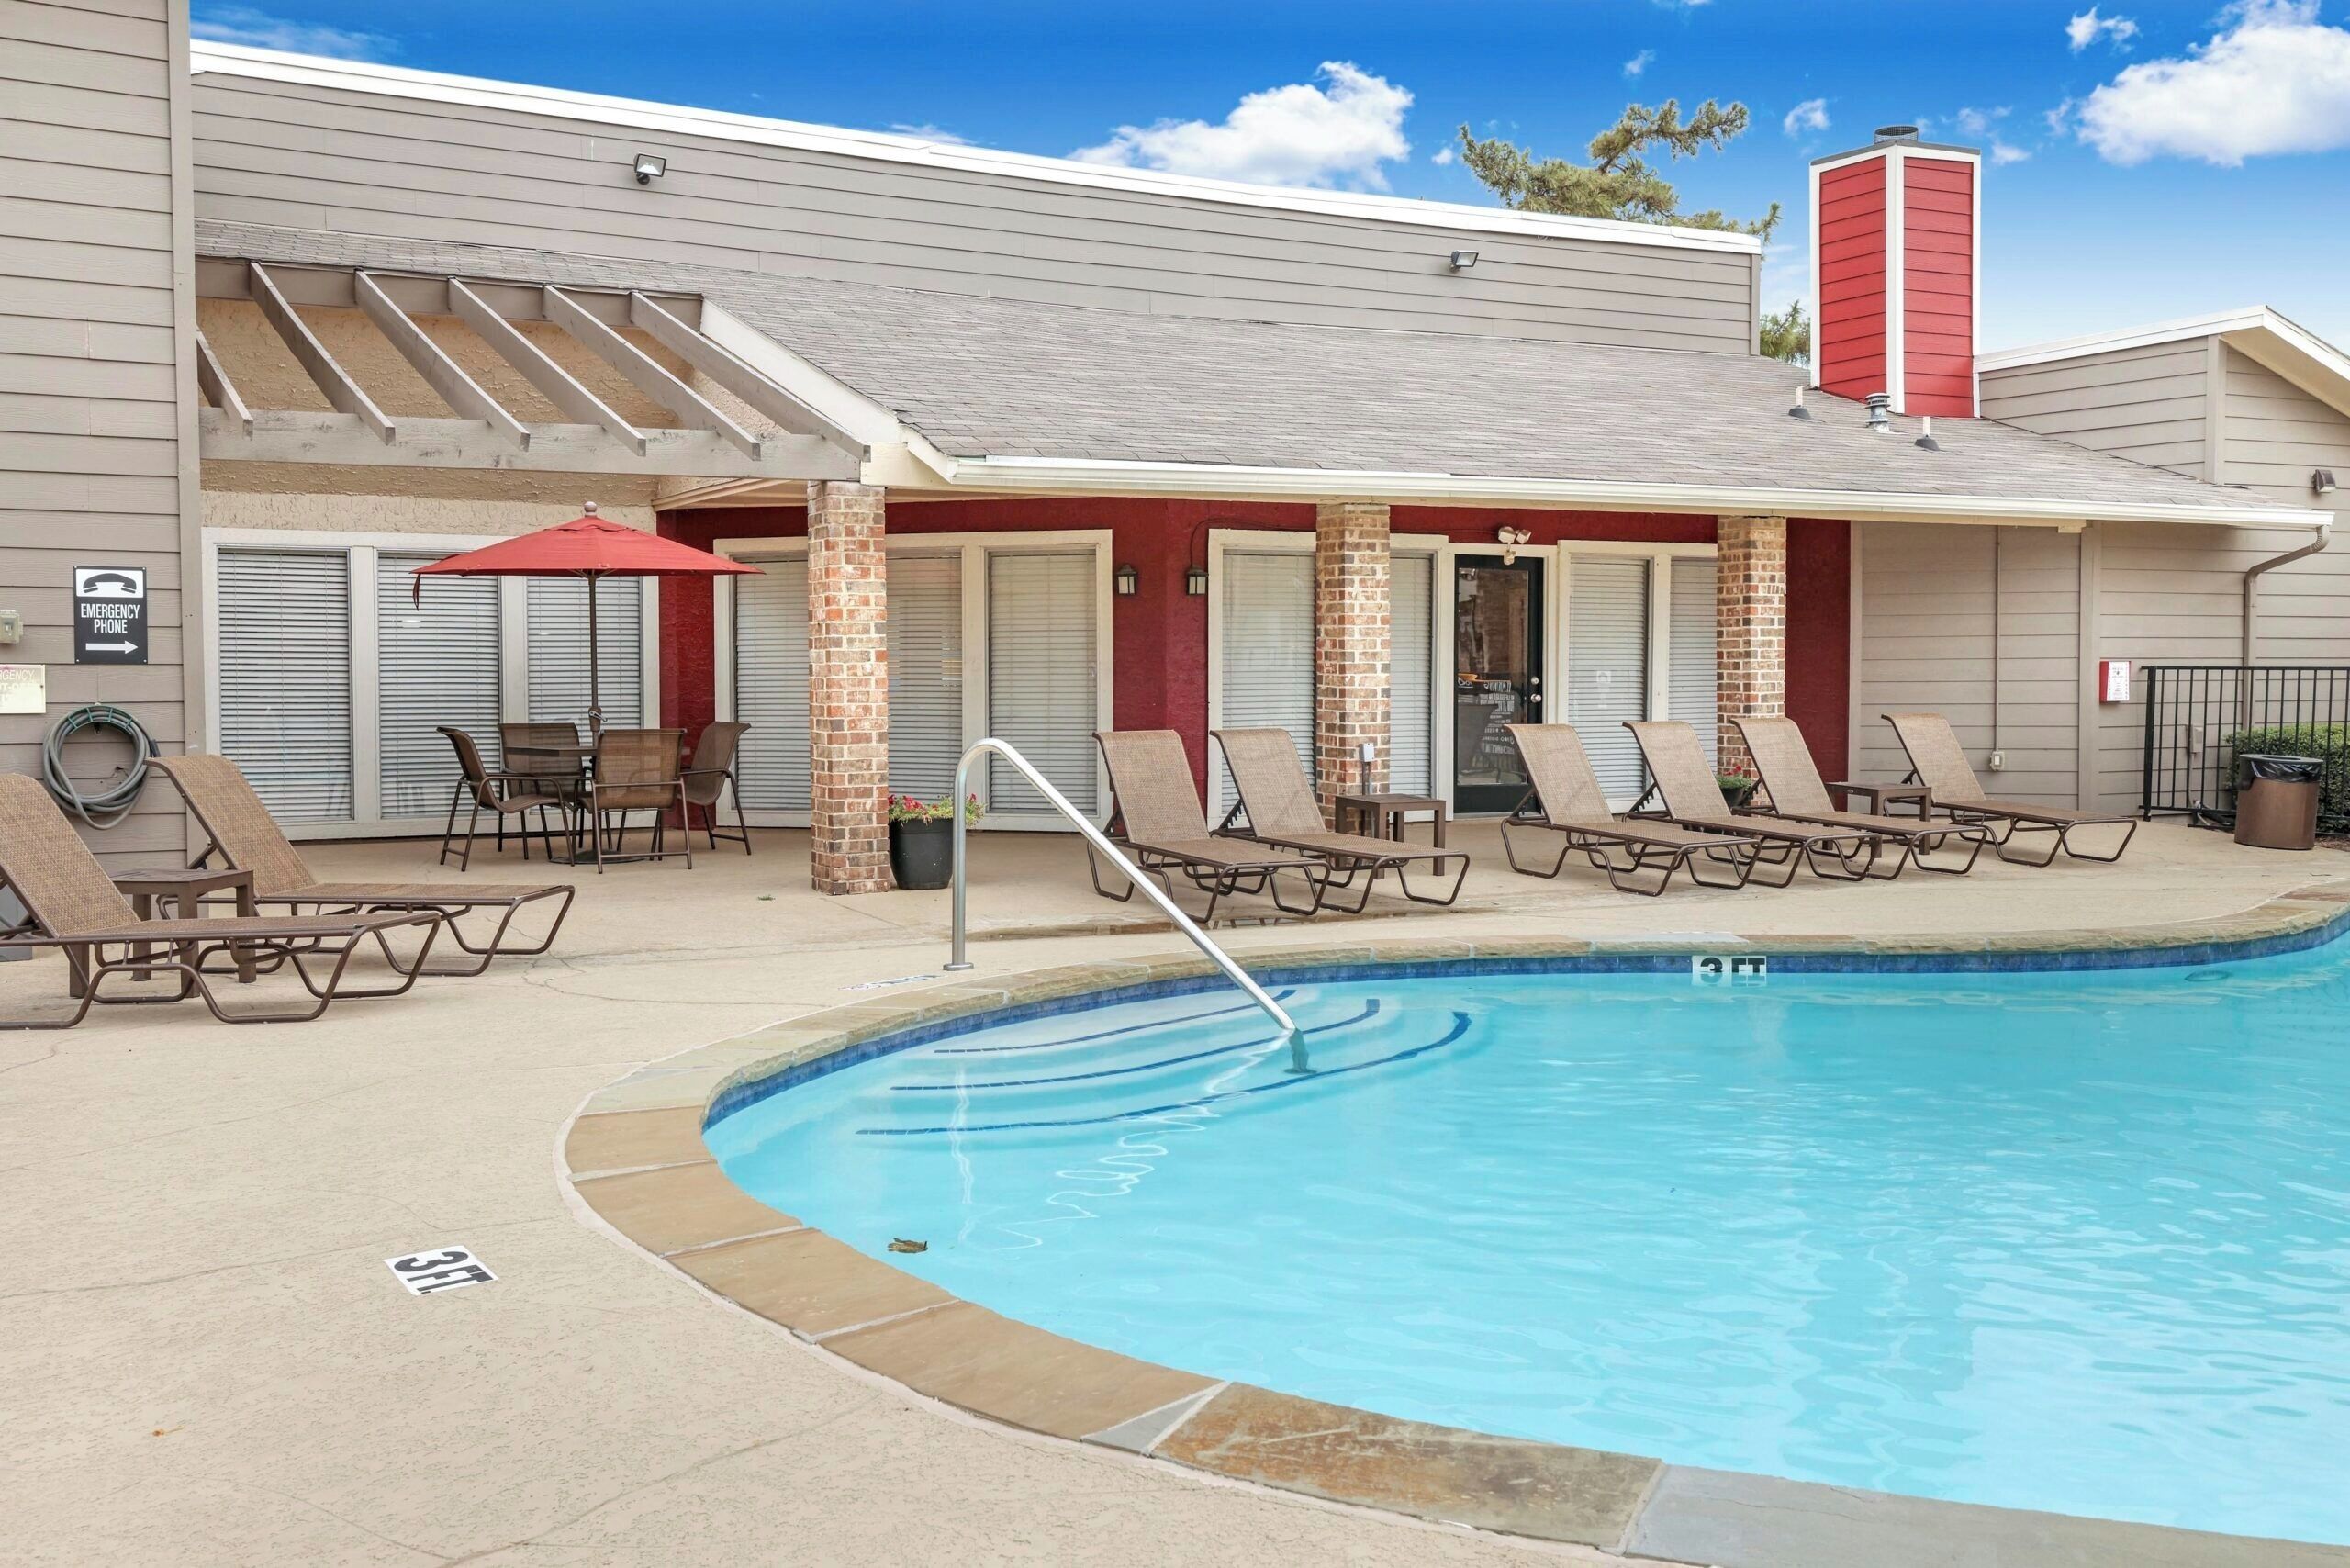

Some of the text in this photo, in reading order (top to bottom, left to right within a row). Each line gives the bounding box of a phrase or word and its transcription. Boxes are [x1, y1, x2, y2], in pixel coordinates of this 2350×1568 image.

[81, 603, 140, 619] EMERGENCY
[94, 619, 128, 633] PHONE
[394, 1251, 469, 1272] 3
